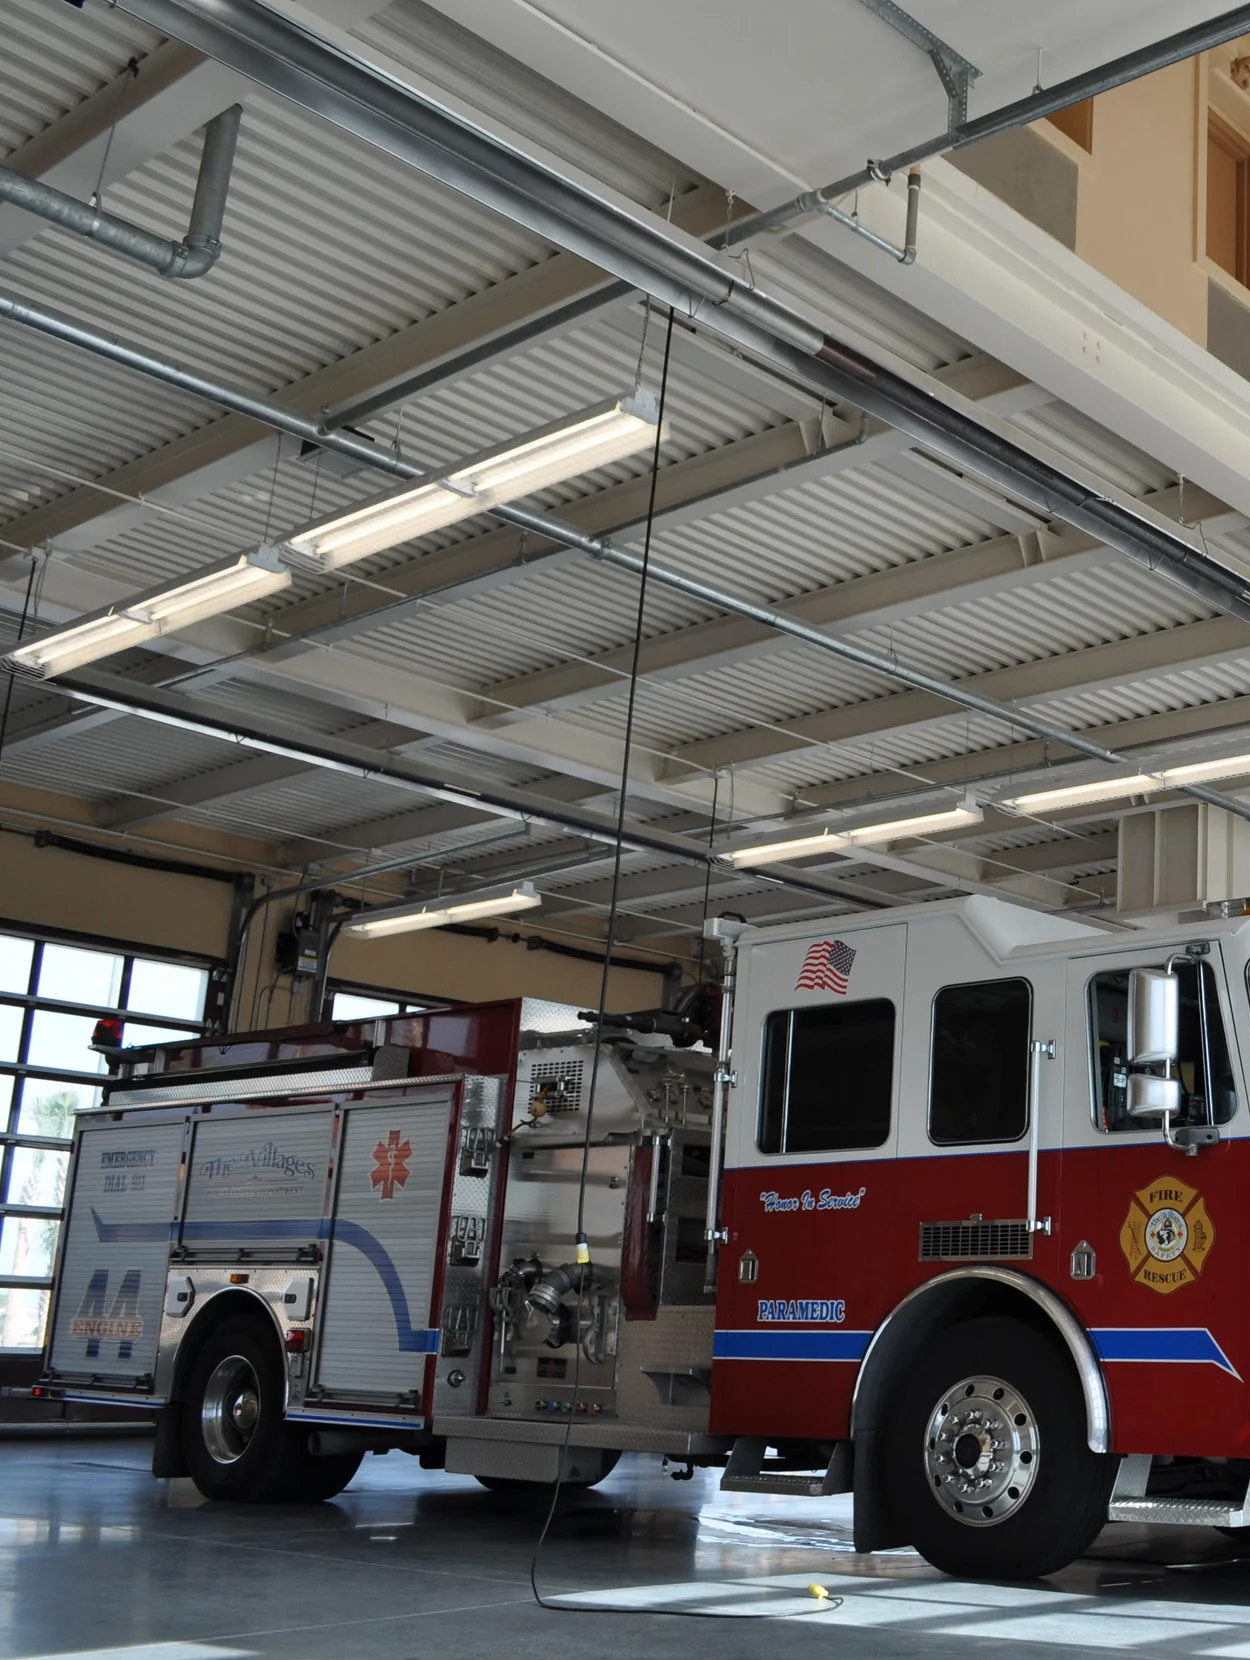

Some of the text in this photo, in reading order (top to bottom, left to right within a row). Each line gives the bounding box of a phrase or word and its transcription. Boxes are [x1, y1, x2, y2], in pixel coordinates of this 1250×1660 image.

[100, 1149, 157, 1169] EMERGENCY
[199, 1141, 316, 1180] The Villages
[103, 1174, 127, 1193] DIAL
[801, 1189, 816, 1211] In
[1149, 1189, 1184, 1204] FIRE
[1143, 1268, 1187, 1284] RESCUE
[757, 1299, 846, 1323] PARAMEDIC
[71, 1319, 142, 1337] ENGINE
